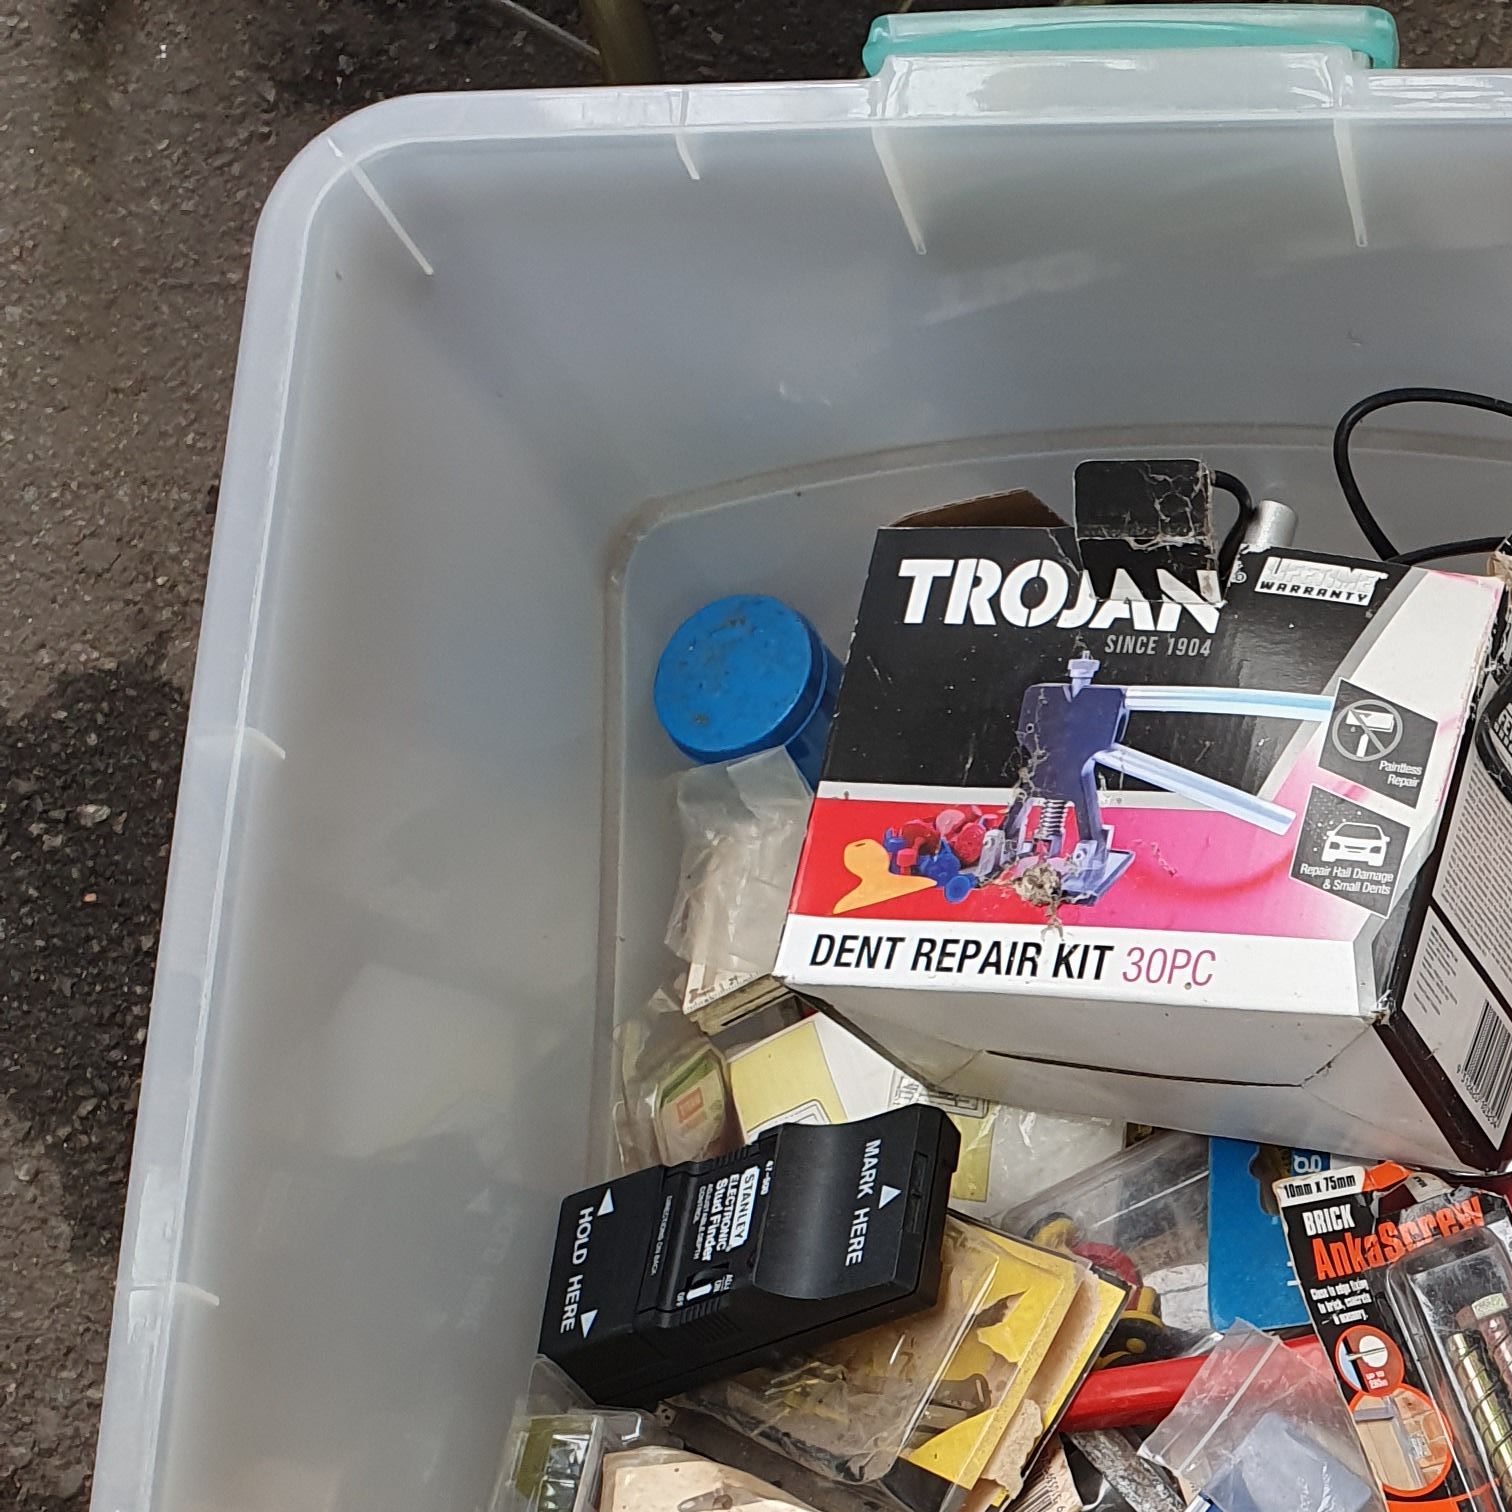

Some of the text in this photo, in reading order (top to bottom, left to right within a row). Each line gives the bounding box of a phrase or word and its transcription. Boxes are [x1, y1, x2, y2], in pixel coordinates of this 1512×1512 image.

[899, 558, 1228, 633] TROJAN
[1260, 580, 1368, 603] WARRANTY
[1105, 634, 1213, 658] SINCE 1904
[1379, 760, 1423, 775] Paintless
[1387, 774, 1420, 789] Repair
[1300, 864, 1394, 883] Repair Hail Damage
[1323, 880, 1391, 895] & Small Dents
[810, 934, 1217, 987] DENT REPAIR KIT 30PC
[734, 1173, 755, 1240] STANLEY
[845, 1139, 882, 1266] MARK HERE
[1284, 1174, 1356, 1198] 10mm 75mm
[702, 1178, 728, 1261] Stud Finder
[716, 1174, 740, 1251] ELECTRONIC
[1302, 1204, 1355, 1236] BRICK
[1311, 1196, 1485, 1281] AnkaScrew
[561, 1207, 593, 1334] HOLD HERE
